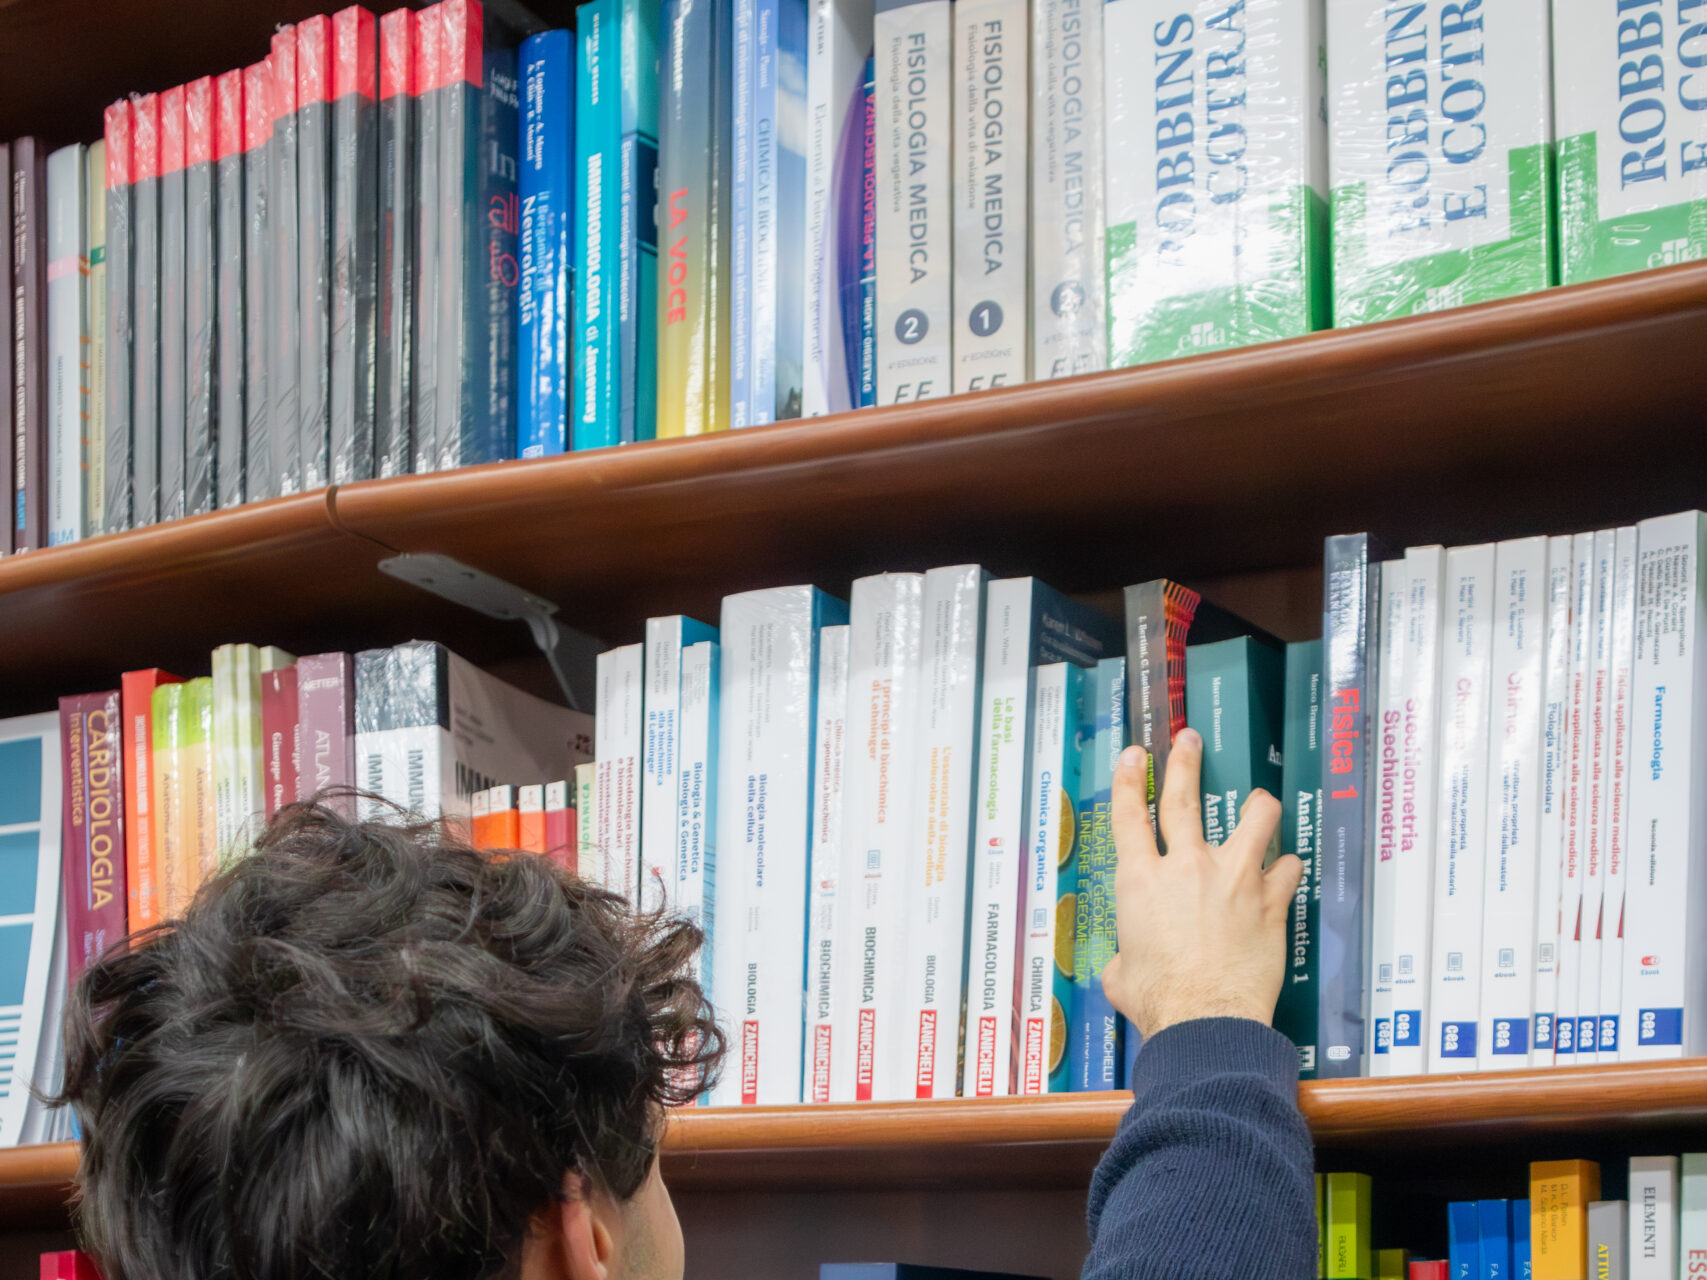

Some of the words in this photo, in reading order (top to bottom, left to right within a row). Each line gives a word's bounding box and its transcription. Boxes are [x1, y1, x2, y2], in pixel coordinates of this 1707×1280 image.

[906, 32, 927, 177] FISIOLOGIA
[982, 20, 1004, 166] FISIOLOGIA
[812, 103, 828, 171] Elementi
[621, 141, 633, 189] Elementi
[862, 94, 877, 245] PREADOLESCENZA
[621, 192, 632, 202] di
[668, 188, 689, 232] LA
[586, 153, 602, 322] IMMUNOBIOLOGIA
[618, 205, 631, 258] oncologia
[908, 184, 928, 286] MEDICA
[984, 175, 1003, 277] MEDICA
[519, 196, 538, 325] Neurologia
[666, 236, 688, 327] VOCE
[863, 248, 876, 271] LA
[586, 326, 600, 341] di
[902, 317, 920, 339] 2
[979, 307, 993, 332] 1
[582, 345, 600, 423] Janeway
[1004, 697, 1016, 712] Le
[1212, 677, 1223, 705] Marco
[1307, 674, 1319, 701] Marco
[1571, 672, 1584, 703] Fisica
[1593, 670, 1606, 701] Fisica
[992, 698, 1004, 729] della
[1003, 716, 1015, 744] basi
[1213, 707, 1225, 752] Bramanti
[1307, 704, 1318, 750] Bramanti
[1330, 689, 1360, 773] Fisica
[1566, 707, 1582, 754] applicata
[1588, 705, 1603, 753] applicata
[1649, 686, 1667, 780] Farmacologia
[664, 709, 675, 775] Introduzione
[69, 711, 86, 826] Interventistica
[691, 761, 703, 808] Biologia
[746, 775, 757, 802] della
[928, 747, 940, 813] molecolare
[938, 746, 953, 817] L'essenziale
[986, 735, 1002, 821] farmacologia
[1380, 710, 1400, 862] Stechiometria
[1401, 698, 1423, 852] Stechiometria
[1570, 758, 1581, 781] alle
[1591, 756, 1602, 780] alle
[86, 708, 115, 912] CARDIOLOGIA
[679, 770, 691, 816] Biologia
[692, 811, 703, 819] &
[756, 774, 768, 820] Biologia
[1037, 771, 1052, 825] Chimica
[1331, 786, 1359, 799] 1
[1568, 785, 1579, 829] scienze
[1590, 782, 1600, 827] scienze
[745, 806, 756, 843] cellula
[926, 818, 937, 845] della
[938, 822, 948, 833] di
[1295, 792, 1314, 853] Analisi
[680, 831, 690, 881] Genetica
[691, 822, 702, 873] Genetica
[755, 823, 766, 887] molecolare
[925, 849, 936, 885] cellula
[934, 838, 947, 881] biologia
[1033, 830, 1050, 891] organica
[1565, 833, 1578, 877] mediche
[1588, 830, 1600, 875] mediche
[1294, 859, 1312, 962] Matematica
[817, 939, 832, 1019] BIOCHIMICA
[861, 926, 877, 1002] BIOCHIMICA
[923, 954, 937, 1002] BIOLOGIA
[981, 904, 1000, 1011] FARMACOLOGIA
[1294, 973, 1310, 982] 1
[745, 963, 758, 1015] BIOLOGIA
[1029, 956, 1046, 1012] CHIMICA
[857, 1010, 874, 1083] ZANICHELLI
[918, 1010, 936, 1084] ZANICHELLI
[1376, 1022, 1392, 1045] cea
[1398, 1013, 1413, 1039] cea
[1443, 1025, 1459, 1050] cea
[1496, 1021, 1512, 1046] cea
[1536, 1016, 1550, 1040] cea
[1558, 1021, 1573, 1046] cea
[1579, 1020, 1594, 1045] cea
[1601, 1019, 1616, 1044] cea
[1640, 1011, 1656, 1037] cea
[742, 1022, 756, 1093] ZANICHELLI
[813, 1026, 830, 1101] ZANICHELLI
[978, 1018, 996, 1094] ZANICHELLI
[1024, 1019, 1043, 1097] ZANICHELLI
[1103, 1015, 1116, 1082] ZANICHELLI
[1642, 1187, 1657, 1257] ELEMENTI
